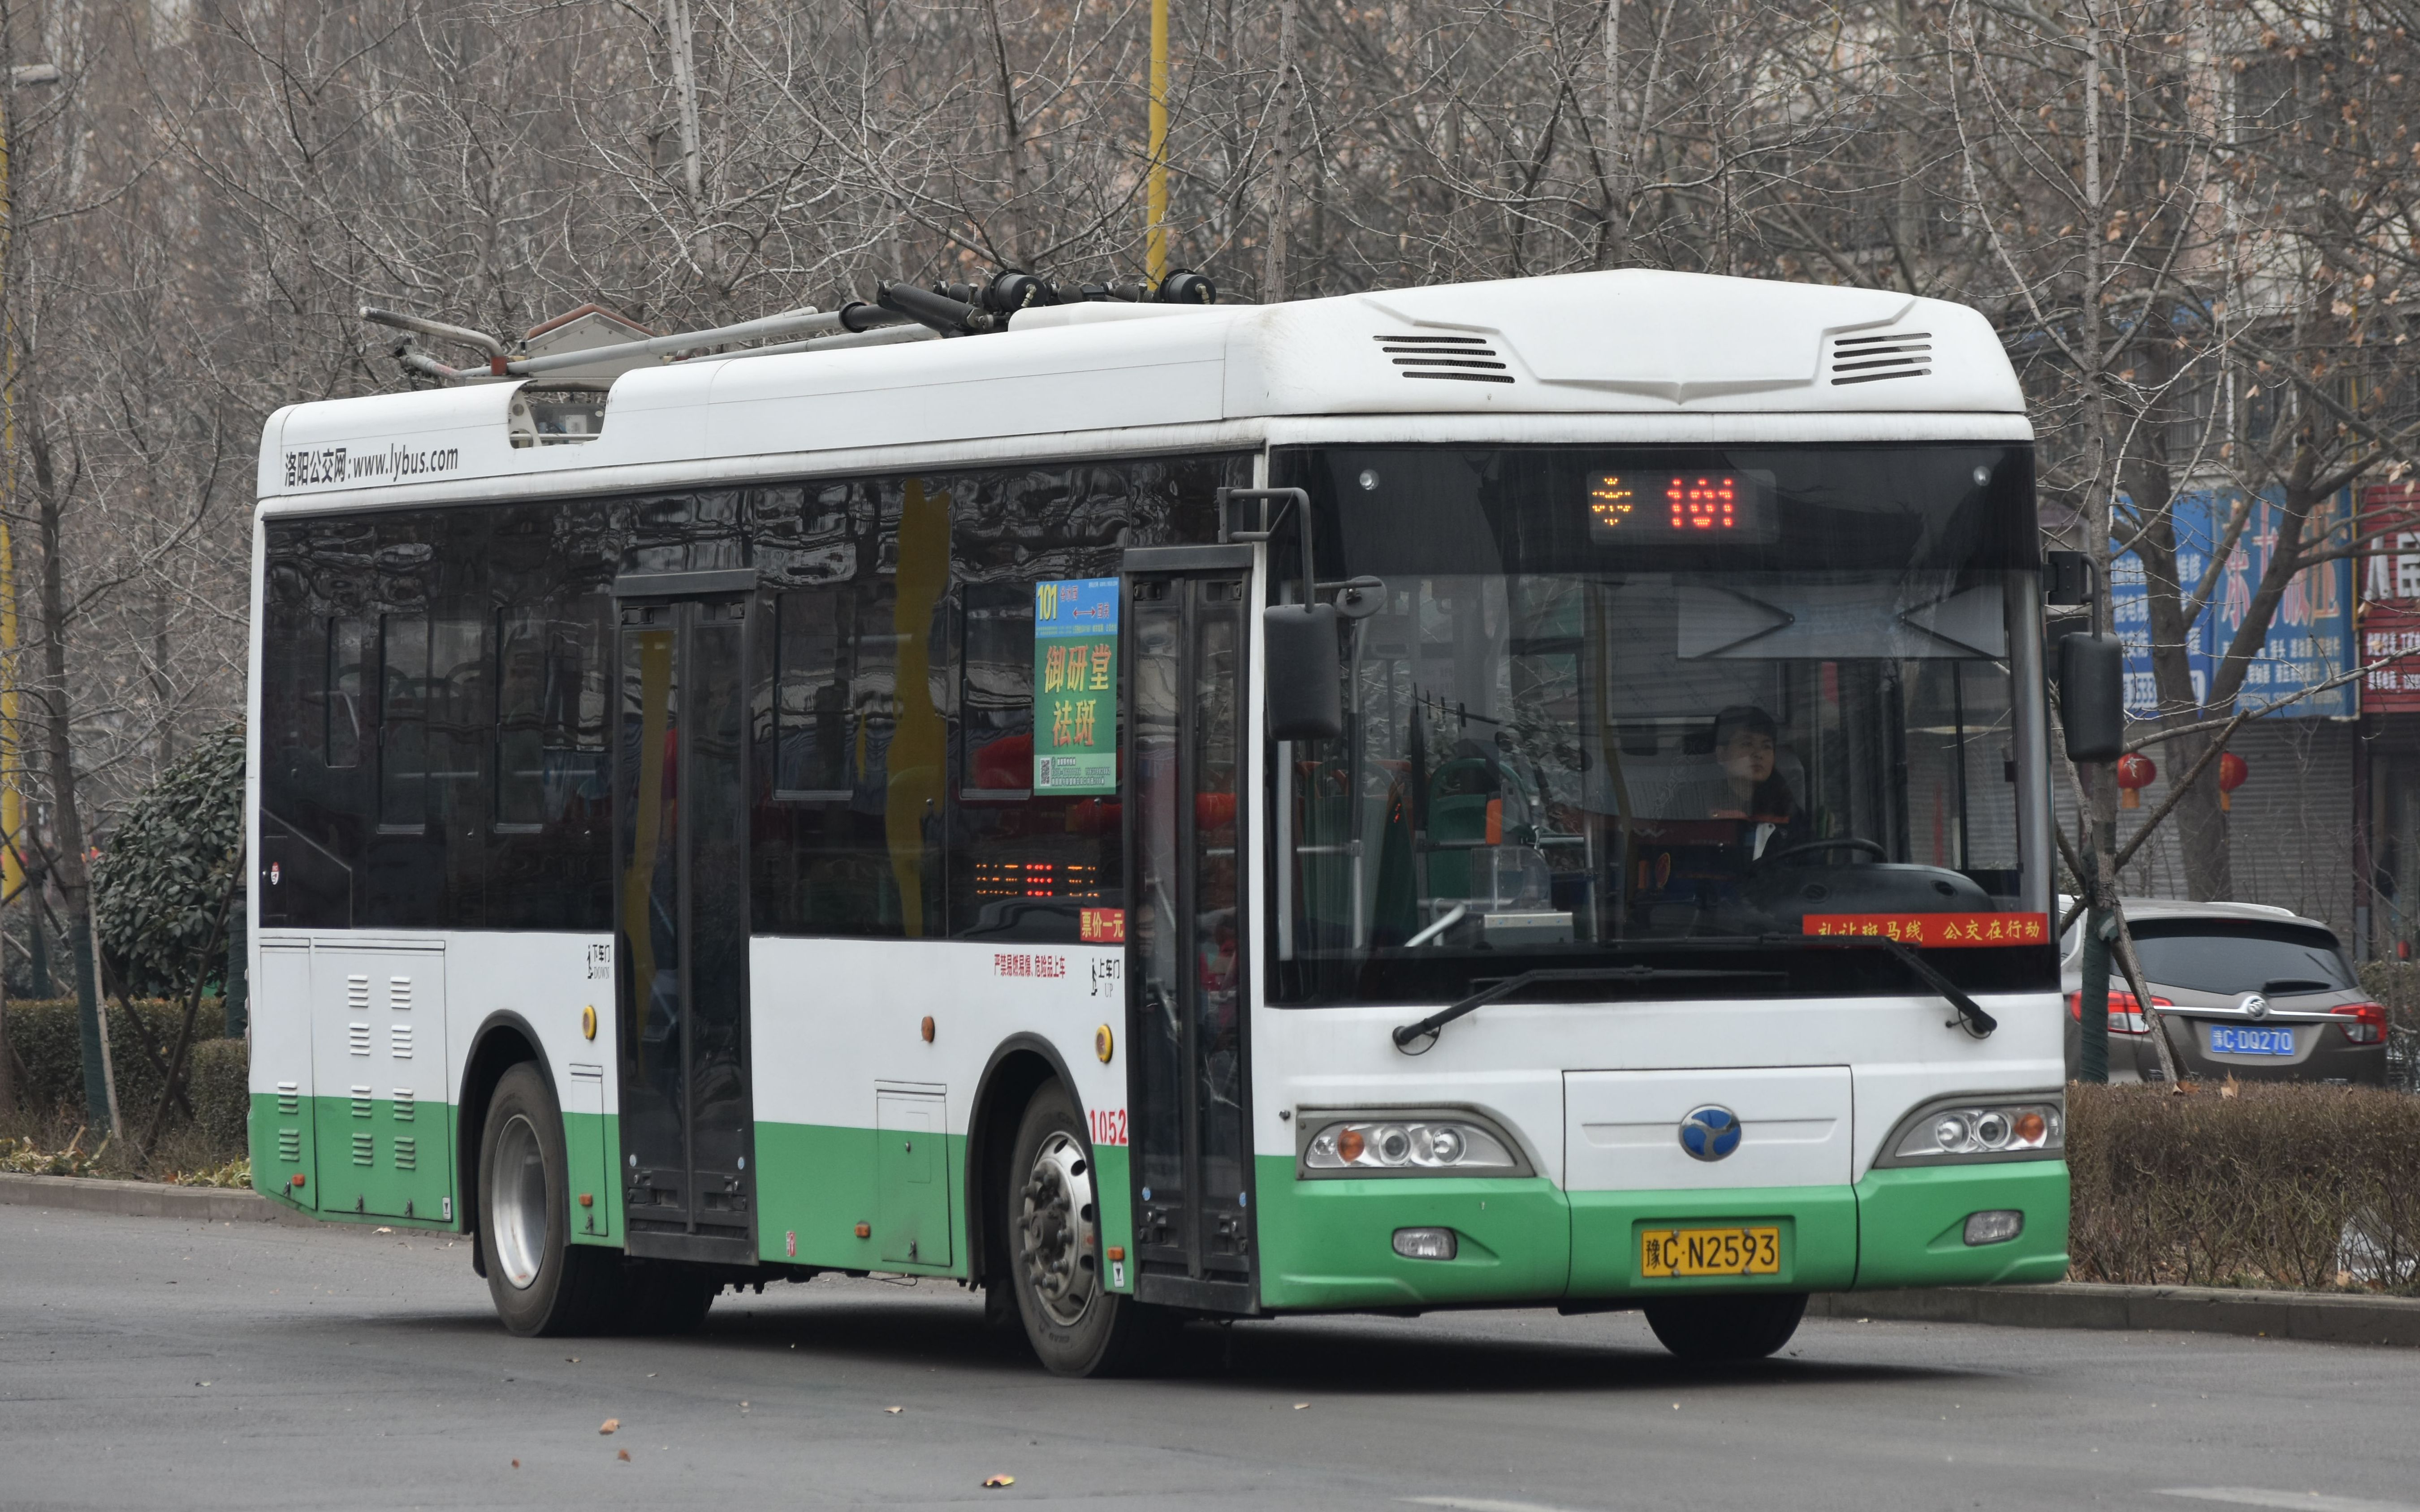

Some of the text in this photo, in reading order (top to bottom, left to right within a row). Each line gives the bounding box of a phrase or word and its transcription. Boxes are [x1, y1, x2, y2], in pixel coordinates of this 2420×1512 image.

[1667, 478, 1733, 528] 101
[1037, 584, 1058, 620] 101
[1045, 643, 1111, 694] 御研堂
[1052, 698, 1096, 748] 祛斑
[1081, 911, 1124, 938] 票价一元
[1943, 918, 2040, 941] 公交在行动
[592, 944, 610, 963] 下车门
[594, 966, 609, 979] DOWN
[1098, 958, 1120, 979] 上车门
[1104, 983, 1114, 998] UP
[1089, 1108, 1128, 1146] 1052
